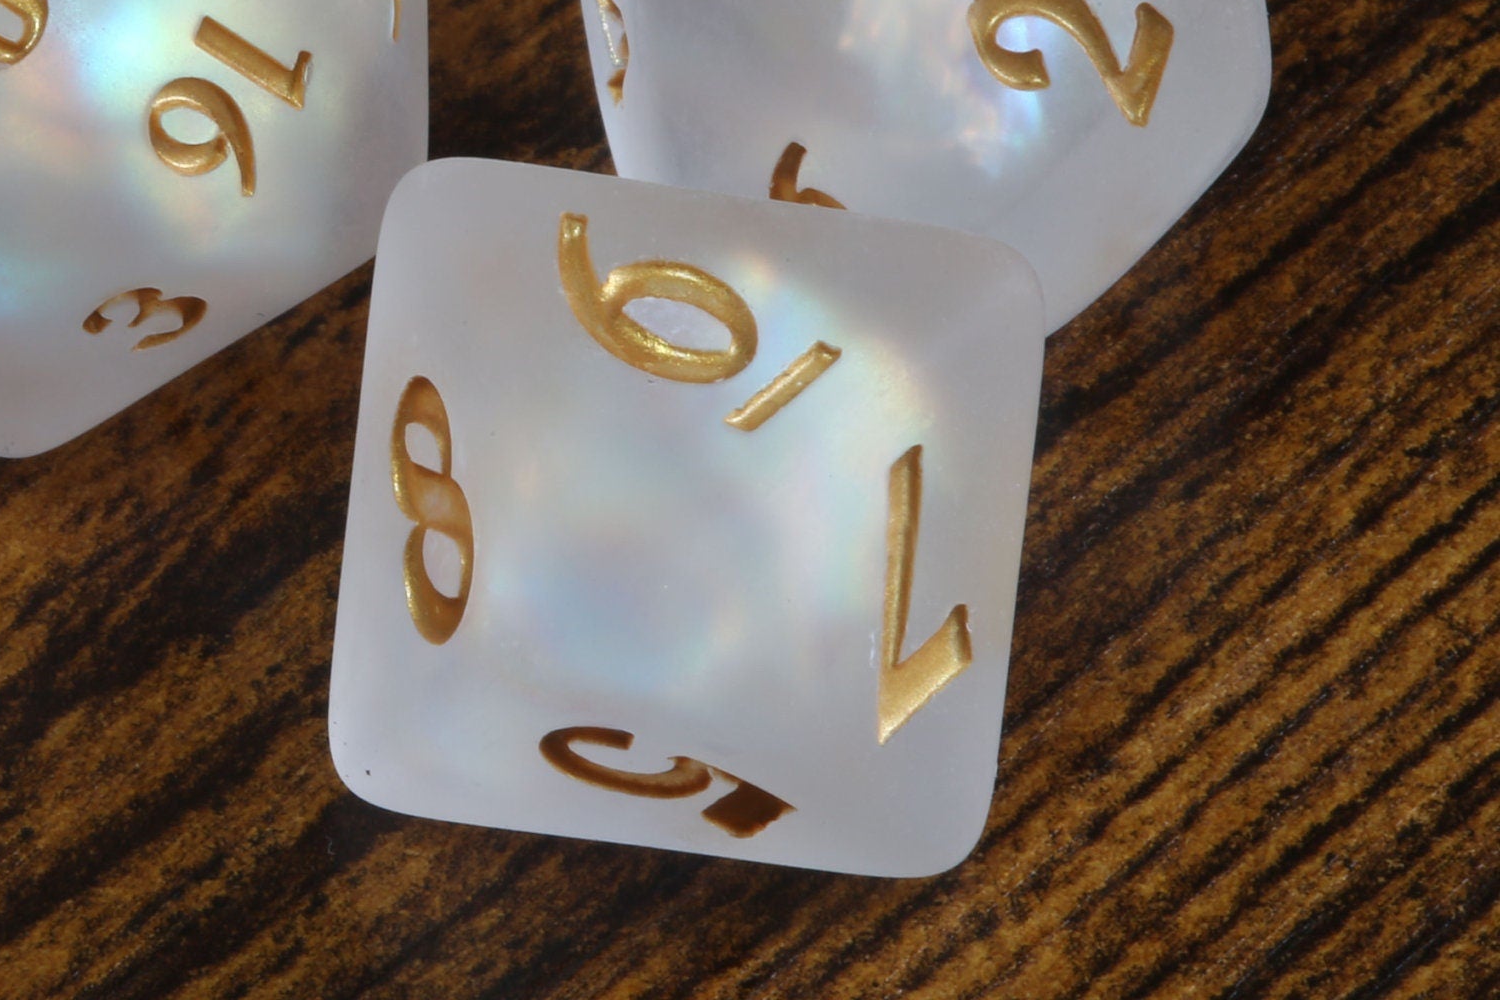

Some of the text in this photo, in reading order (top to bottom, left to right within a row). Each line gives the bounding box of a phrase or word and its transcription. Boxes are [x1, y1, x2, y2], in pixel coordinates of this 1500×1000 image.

[148, 15, 314, 197] 16
[81, 286, 208, 352] 3
[389, 374, 475, 646] 8
